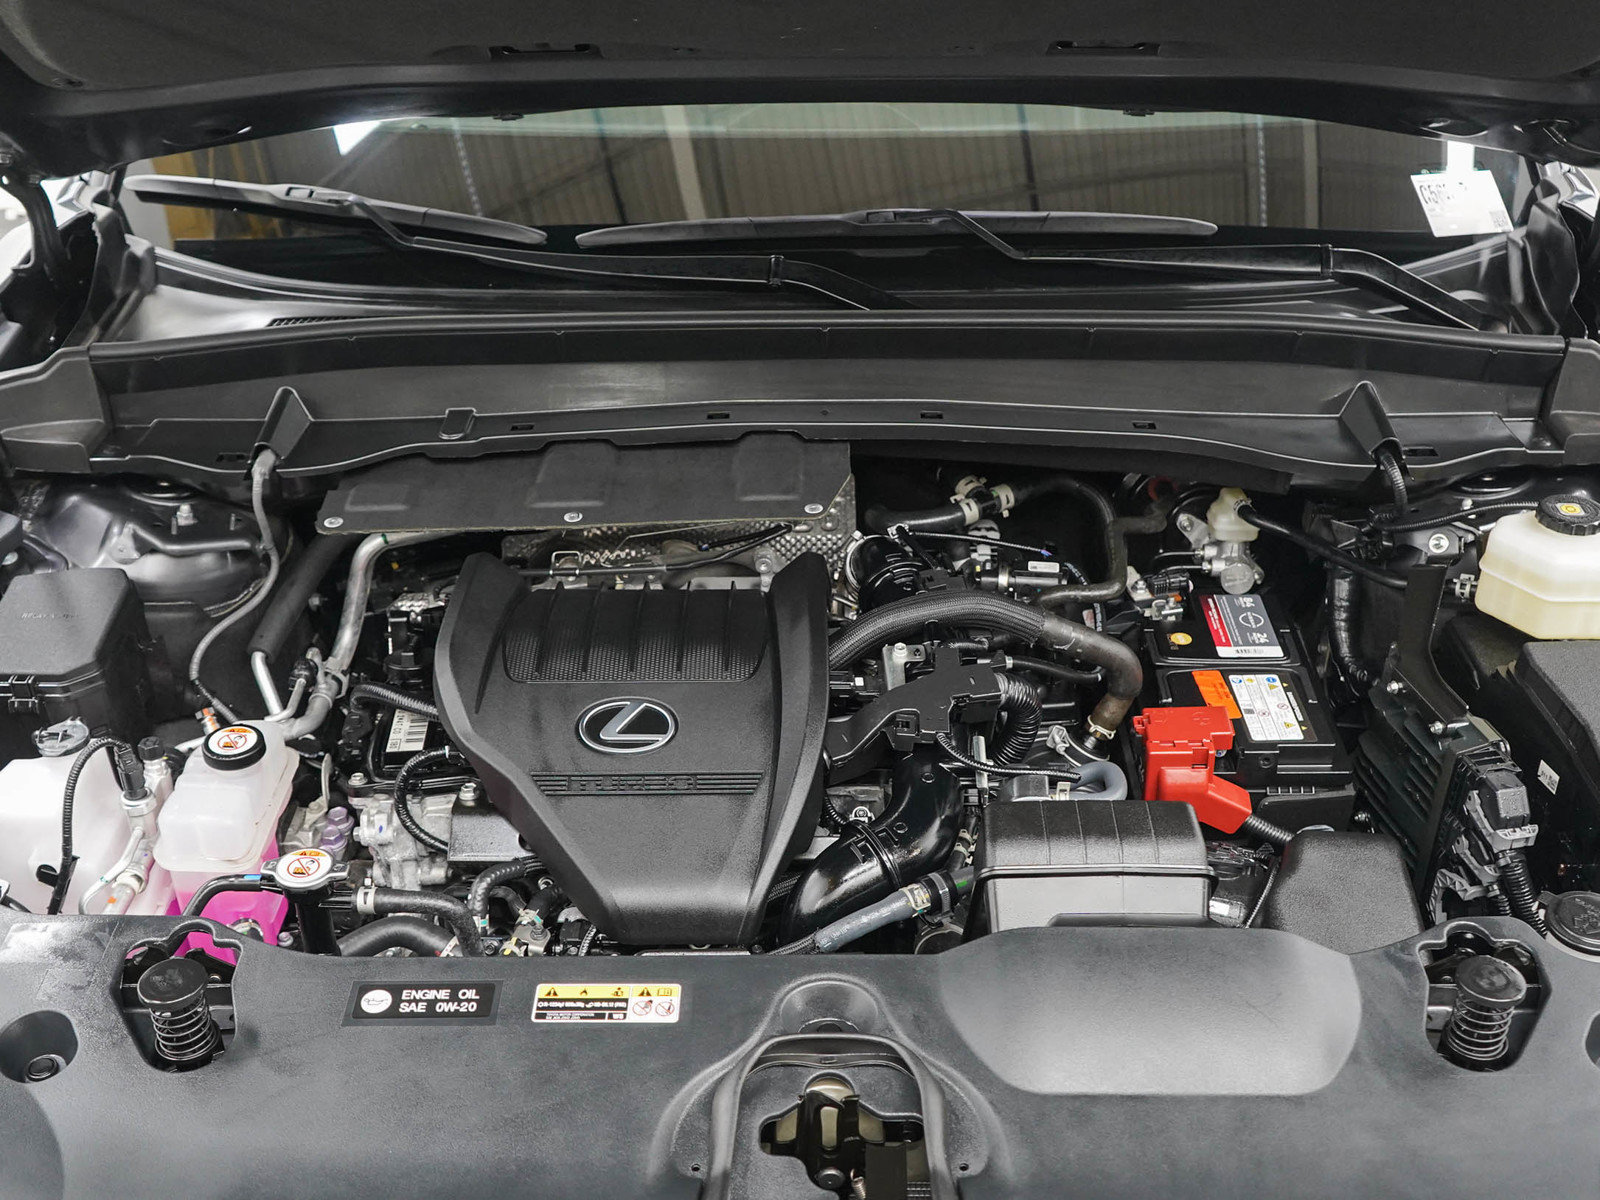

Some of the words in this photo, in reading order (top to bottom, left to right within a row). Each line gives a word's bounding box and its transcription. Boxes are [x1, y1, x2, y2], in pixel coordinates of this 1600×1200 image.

[401, 989, 451, 1000] ENGINE
[458, 989, 480, 1000] OIL
[398, 1002, 427, 1013] SAE
[435, 1001, 477, 1013] 0W-20
